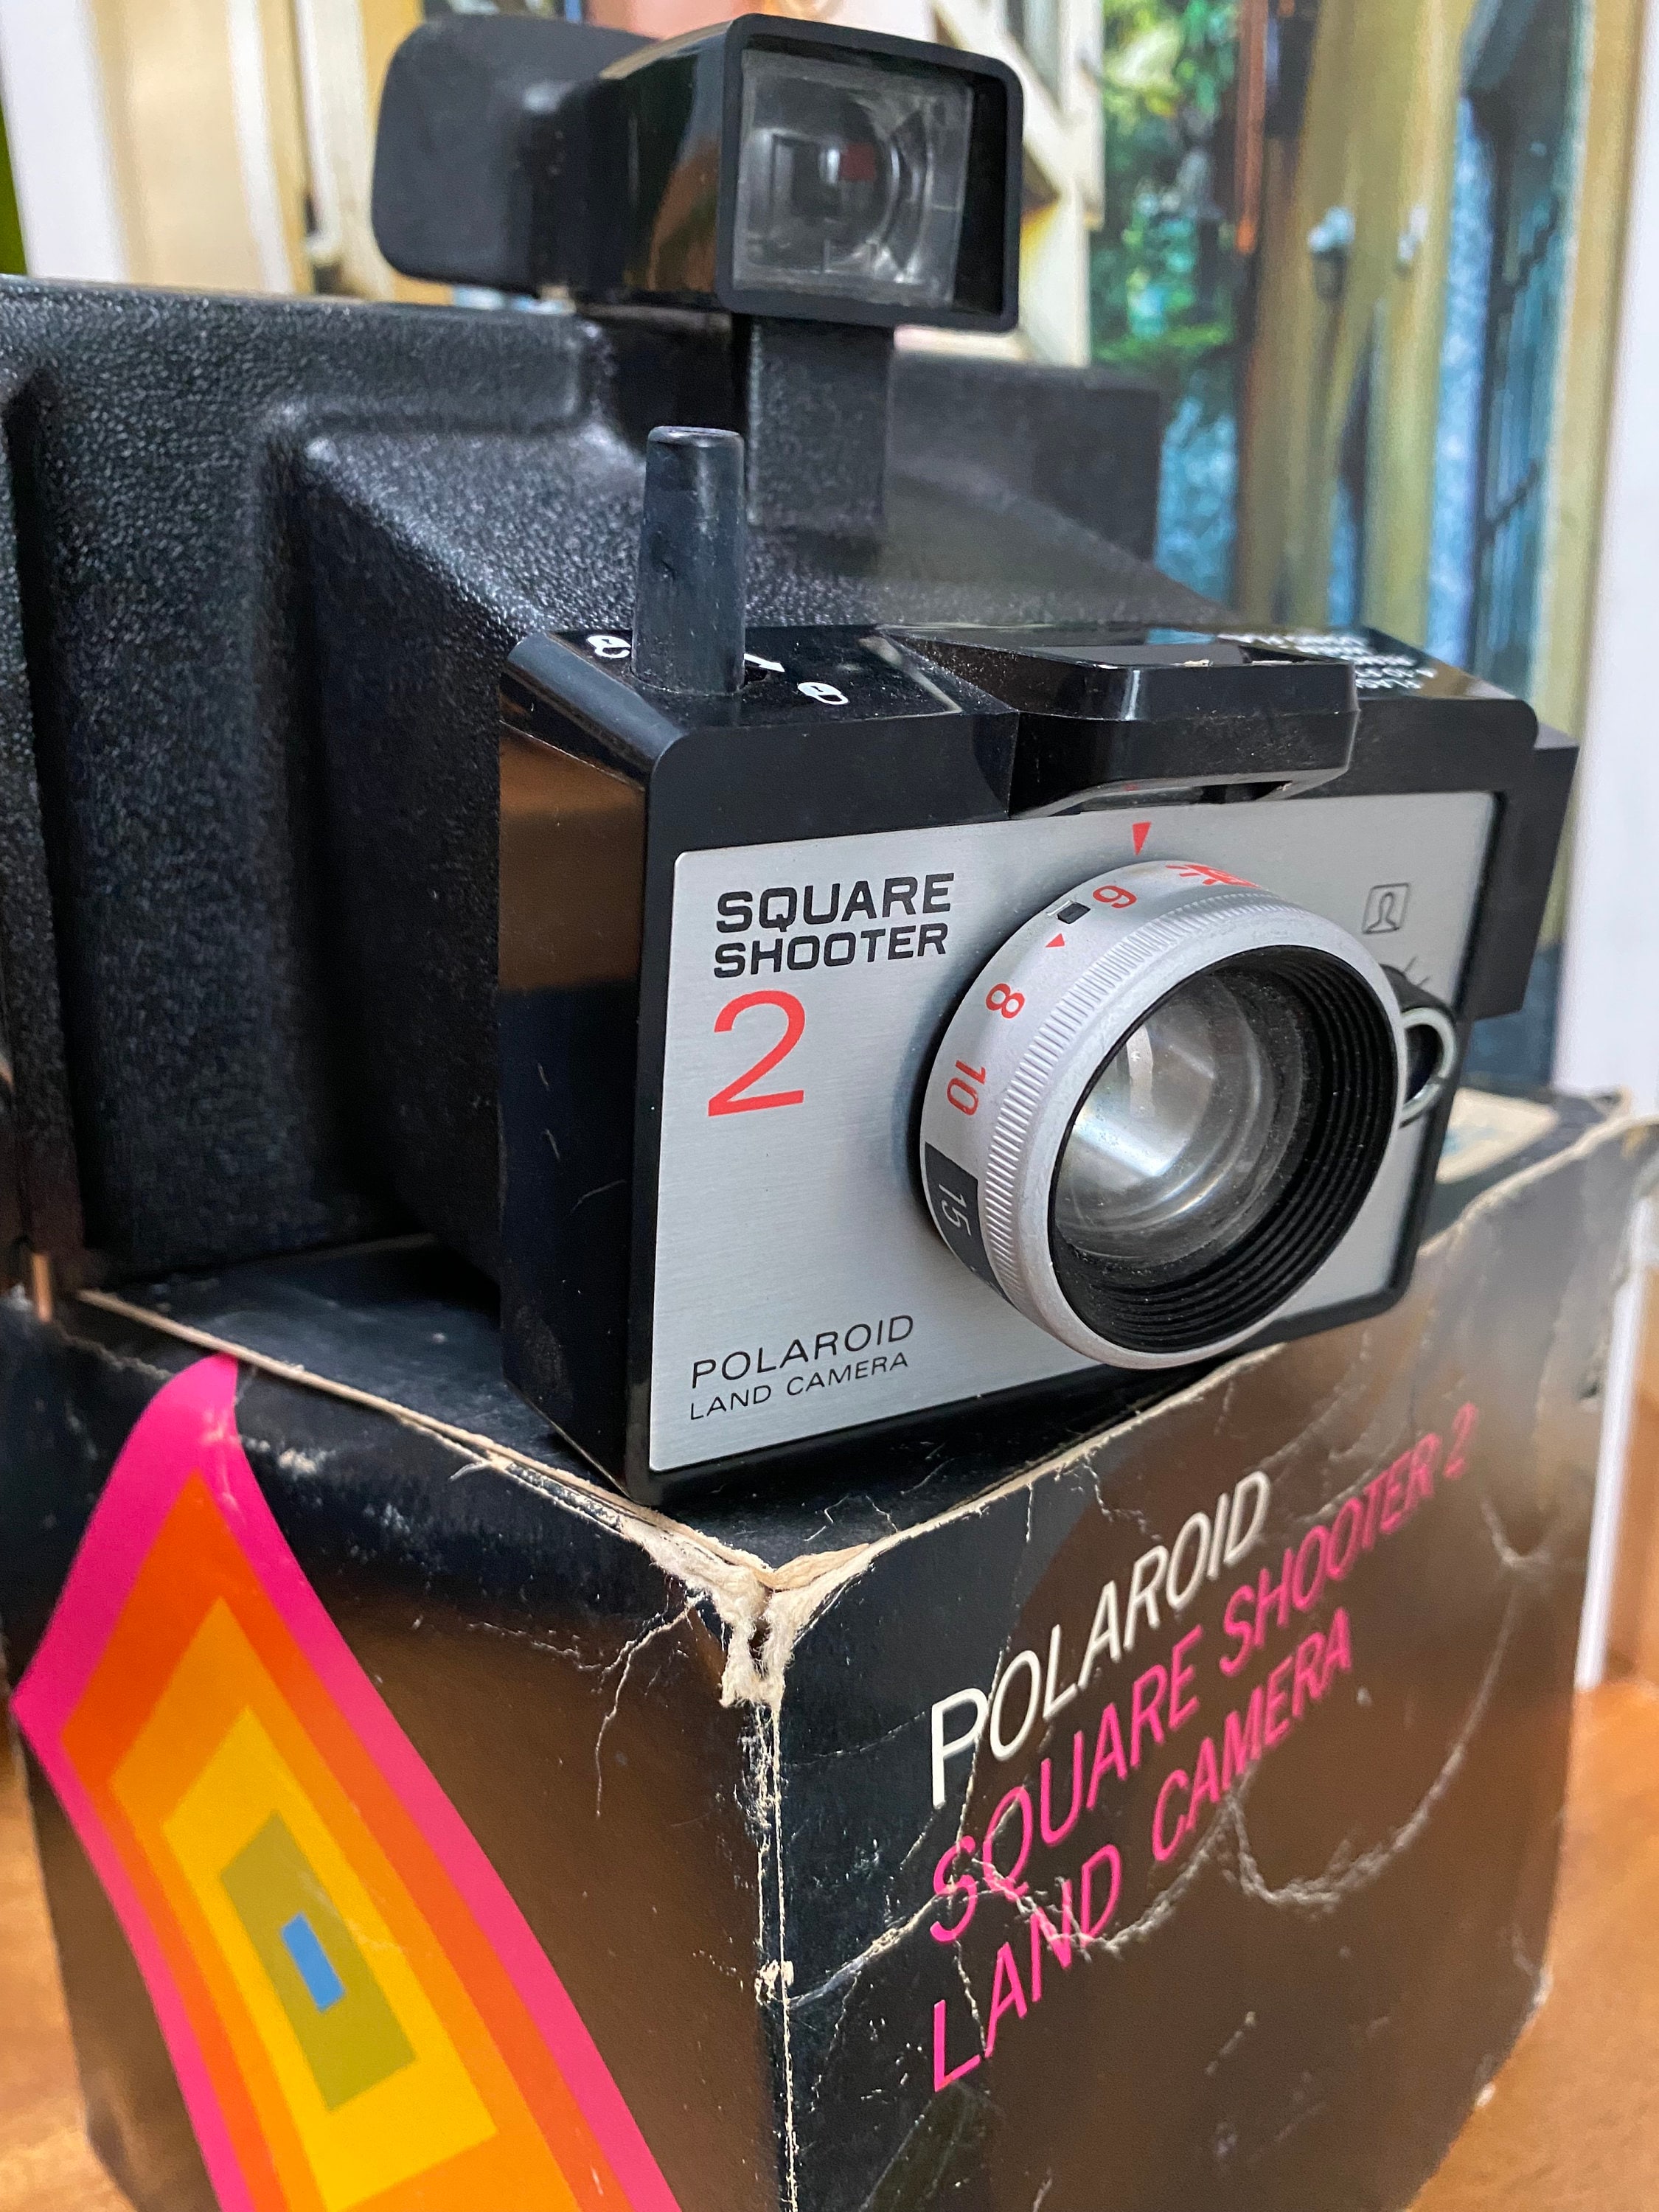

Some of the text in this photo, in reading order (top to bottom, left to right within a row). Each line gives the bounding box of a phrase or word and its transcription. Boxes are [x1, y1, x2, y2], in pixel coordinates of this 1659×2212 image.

[715, 872, 955, 933] SQUARE
[713, 922, 949, 978] SHOOTER
[985, 982, 1026, 1020] 8
[707, 990, 806, 1117] 2
[946, 1059, 987, 1116] 10
[938, 1183, 972, 1237] 15
[690, 1352, 908, 1421] LAND CAMERA
[692, 1315, 914, 1389] POLAROID
[929, 1402, 1478, 1945] SQUARE SHOOTER 2
[930, 1471, 1271, 1809] POLAROID
[932, 1607, 1353, 2094] LAND CAMERA
